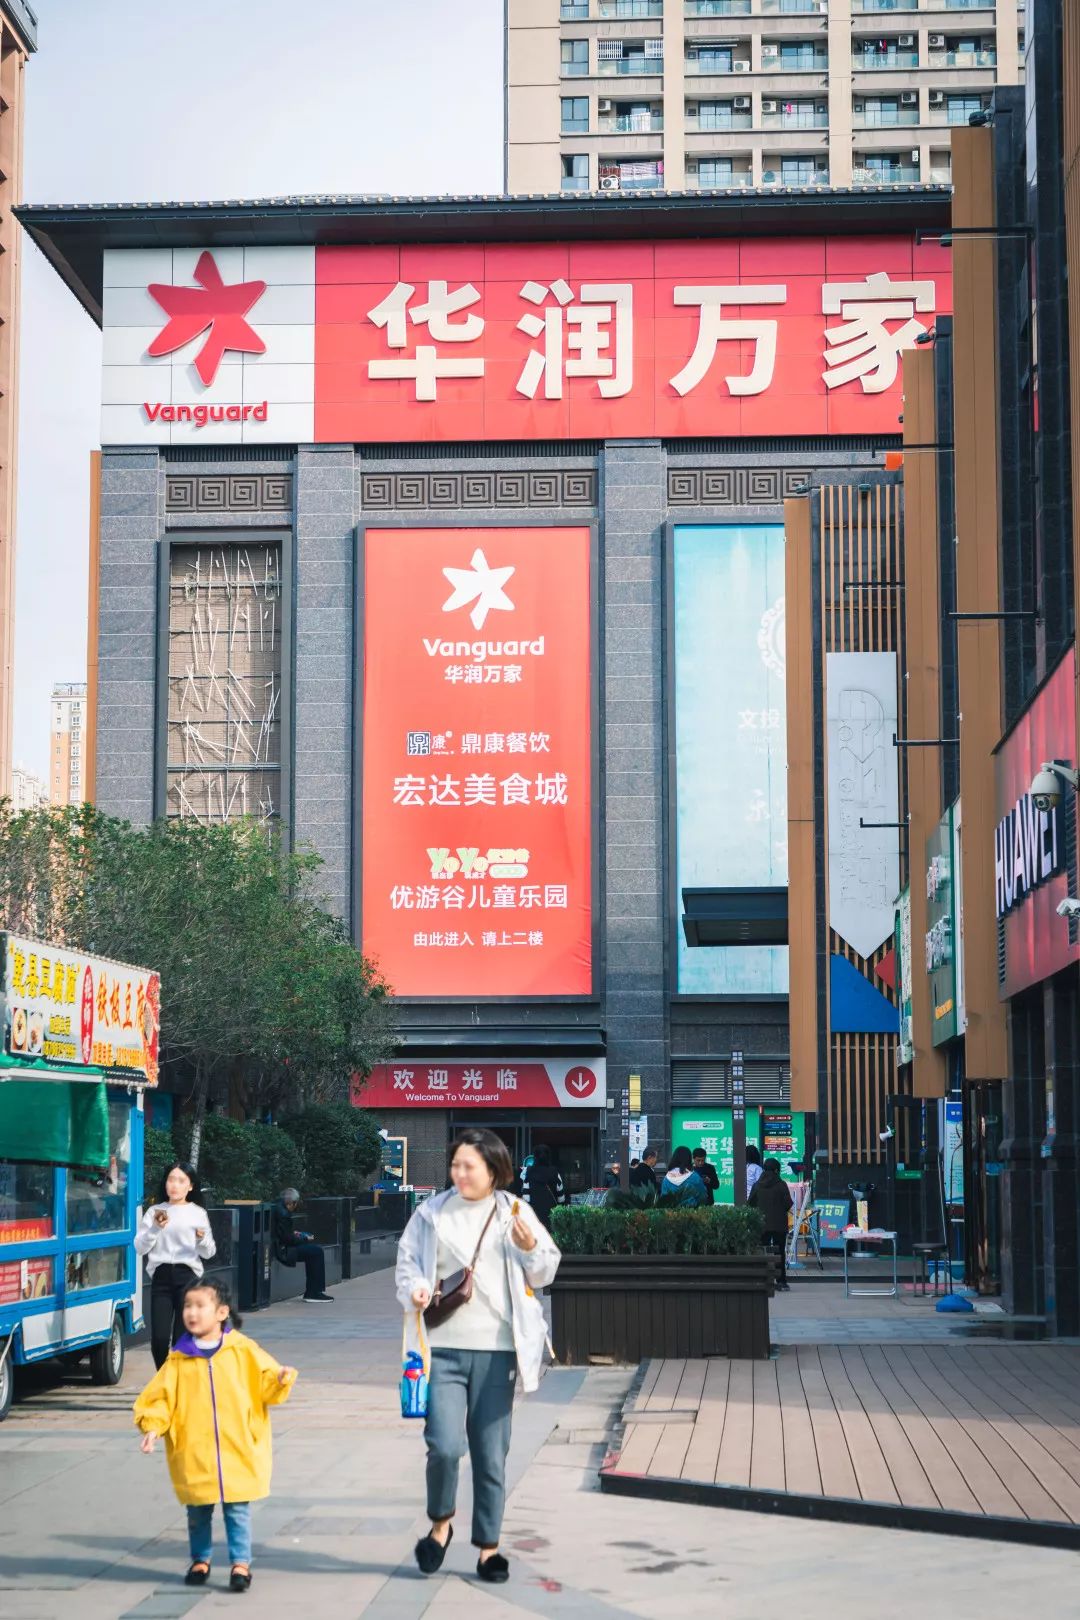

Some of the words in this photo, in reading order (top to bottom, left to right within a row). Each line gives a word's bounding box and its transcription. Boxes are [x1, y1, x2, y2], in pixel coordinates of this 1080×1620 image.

[367, 272, 936, 401] 华润万家
[143, 401, 268, 427] Vanguard
[423, 635, 545, 662] Vanguard
[444, 664, 523, 684] 华润万家
[461, 732, 551, 754] 鼎康餐饮
[393, 773, 569, 807] 宏达美食城
[994, 786, 1058, 918] HUAWEI
[390, 884, 568, 910] 优游谷儿童乐园
[413, 931, 475, 948] 由此进入
[481, 931, 544, 947] 请上二楼
[393, 1068, 518, 1091] 欢迎光临
[405, 1092, 445, 1102] Welcome
[446, 1093, 457, 1102] To
[458, 1093, 500, 1104] Vanguard
